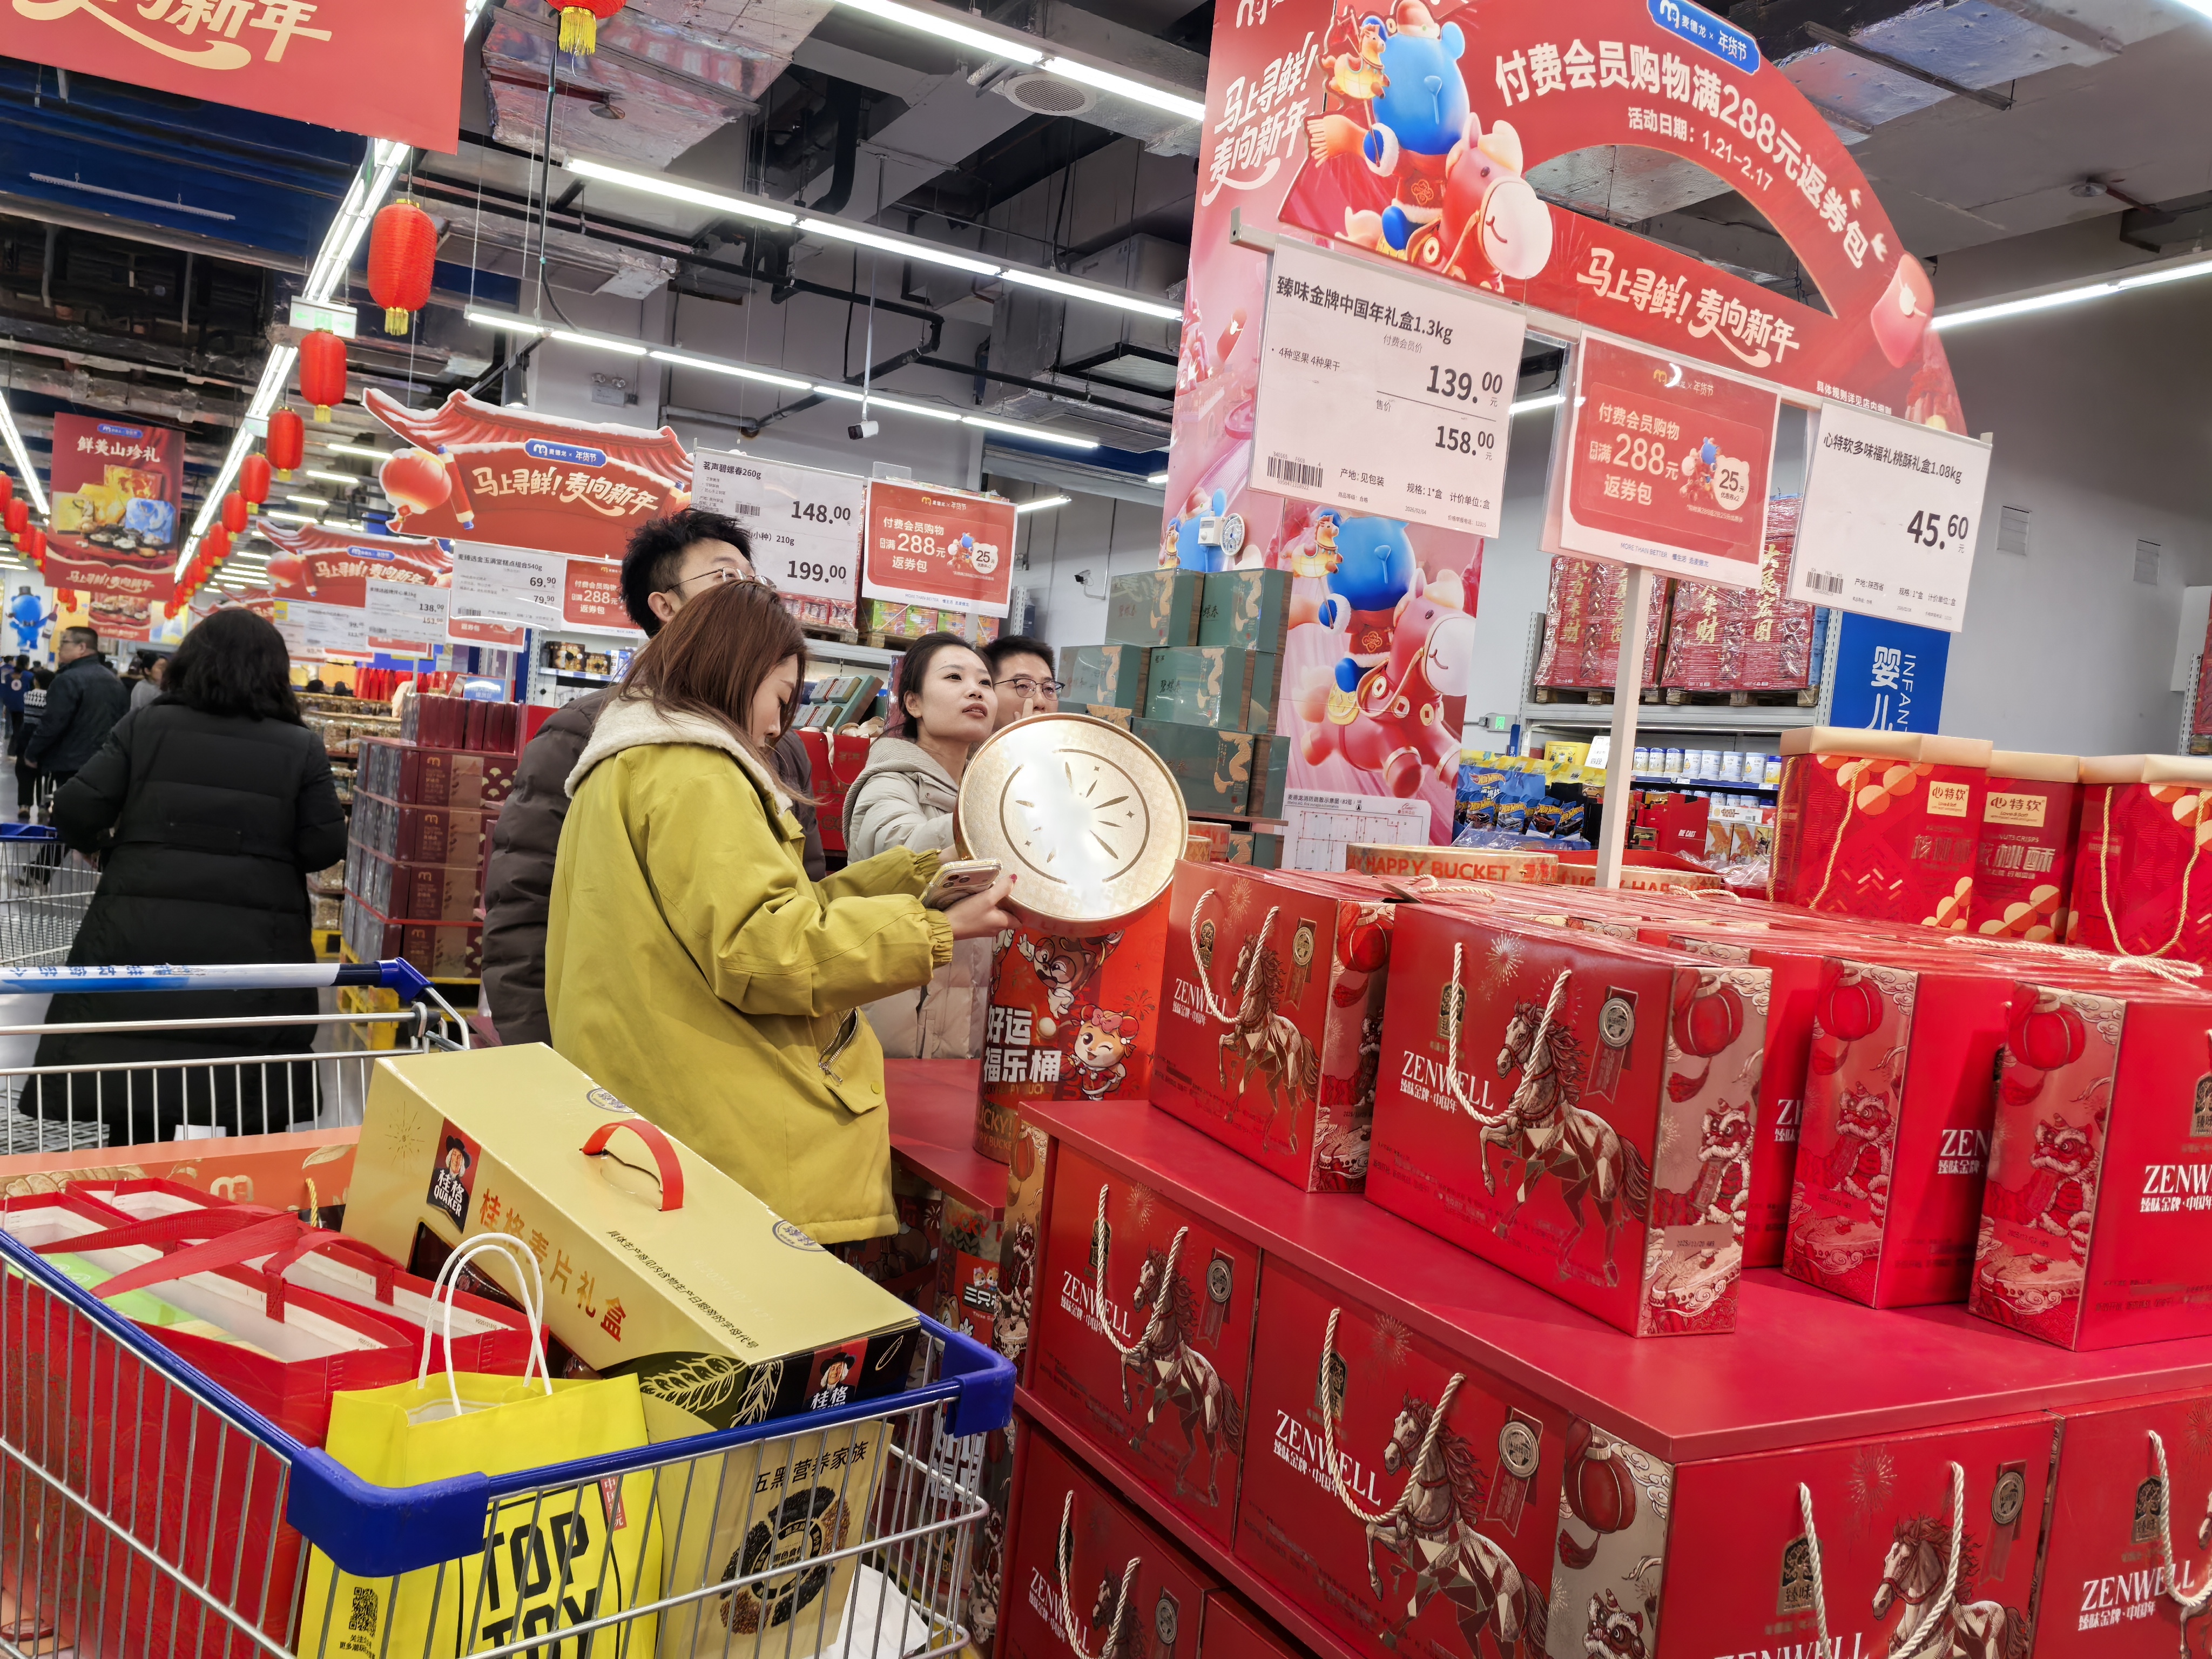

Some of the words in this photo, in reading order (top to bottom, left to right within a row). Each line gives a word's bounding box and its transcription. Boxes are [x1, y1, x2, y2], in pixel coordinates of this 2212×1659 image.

[1681, 15, 1707, 39] 麦德龙
[1718, 29, 1748, 62] 年货节
[1202, 97, 1311, 206] 麦向新年
[1495, 39, 1869, 268] 付费会员购物满288元返券包
[1276, 275, 1453, 345] 臻味金牌中国年礼盒1.3kg
[1279, 347, 1309, 364] 4种坚果
[1311, 355, 1340, 372] 4种果干
[1383, 334, 1422, 354] 付费会员价
[1375, 399, 1392, 413] 售价
[1599, 402, 1680, 441] 付费会员购物
[549, 447, 567, 458] 麦德龙
[575, 451, 597, 463] 年货节
[1823, 433, 1963, 484] 心特软多味福礼桃酥礼盒1.08kg
[1603, 474, 1653, 506] 返券包
[884, 517, 944, 536] 付费会员购物
[1906, 510, 1969, 550] 45.60
[892, 555, 927, 572] 返券包
[579, 604, 605, 615] 返券包
[1897, 653, 1917, 733] INFAN
[1366, 857, 1425, 874] HAPPY
[1431, 861, 1510, 881] BUCKET
[987, 1005, 1032, 1046] 好运
[983, 1048, 1062, 1083] 福乐桶
[977, 1105, 1013, 1138] UCKY!
[437, 1169, 465, 1204] 桂格
[2142, 1164, 2212, 1195] ZENW
[434, 1184, 462, 1218] QUAKER
[480, 1188, 627, 1342] 桂格麦片礼盒
[811, 1386, 847, 1408] 桂格
[482, 1510, 589, 1612] TOP
